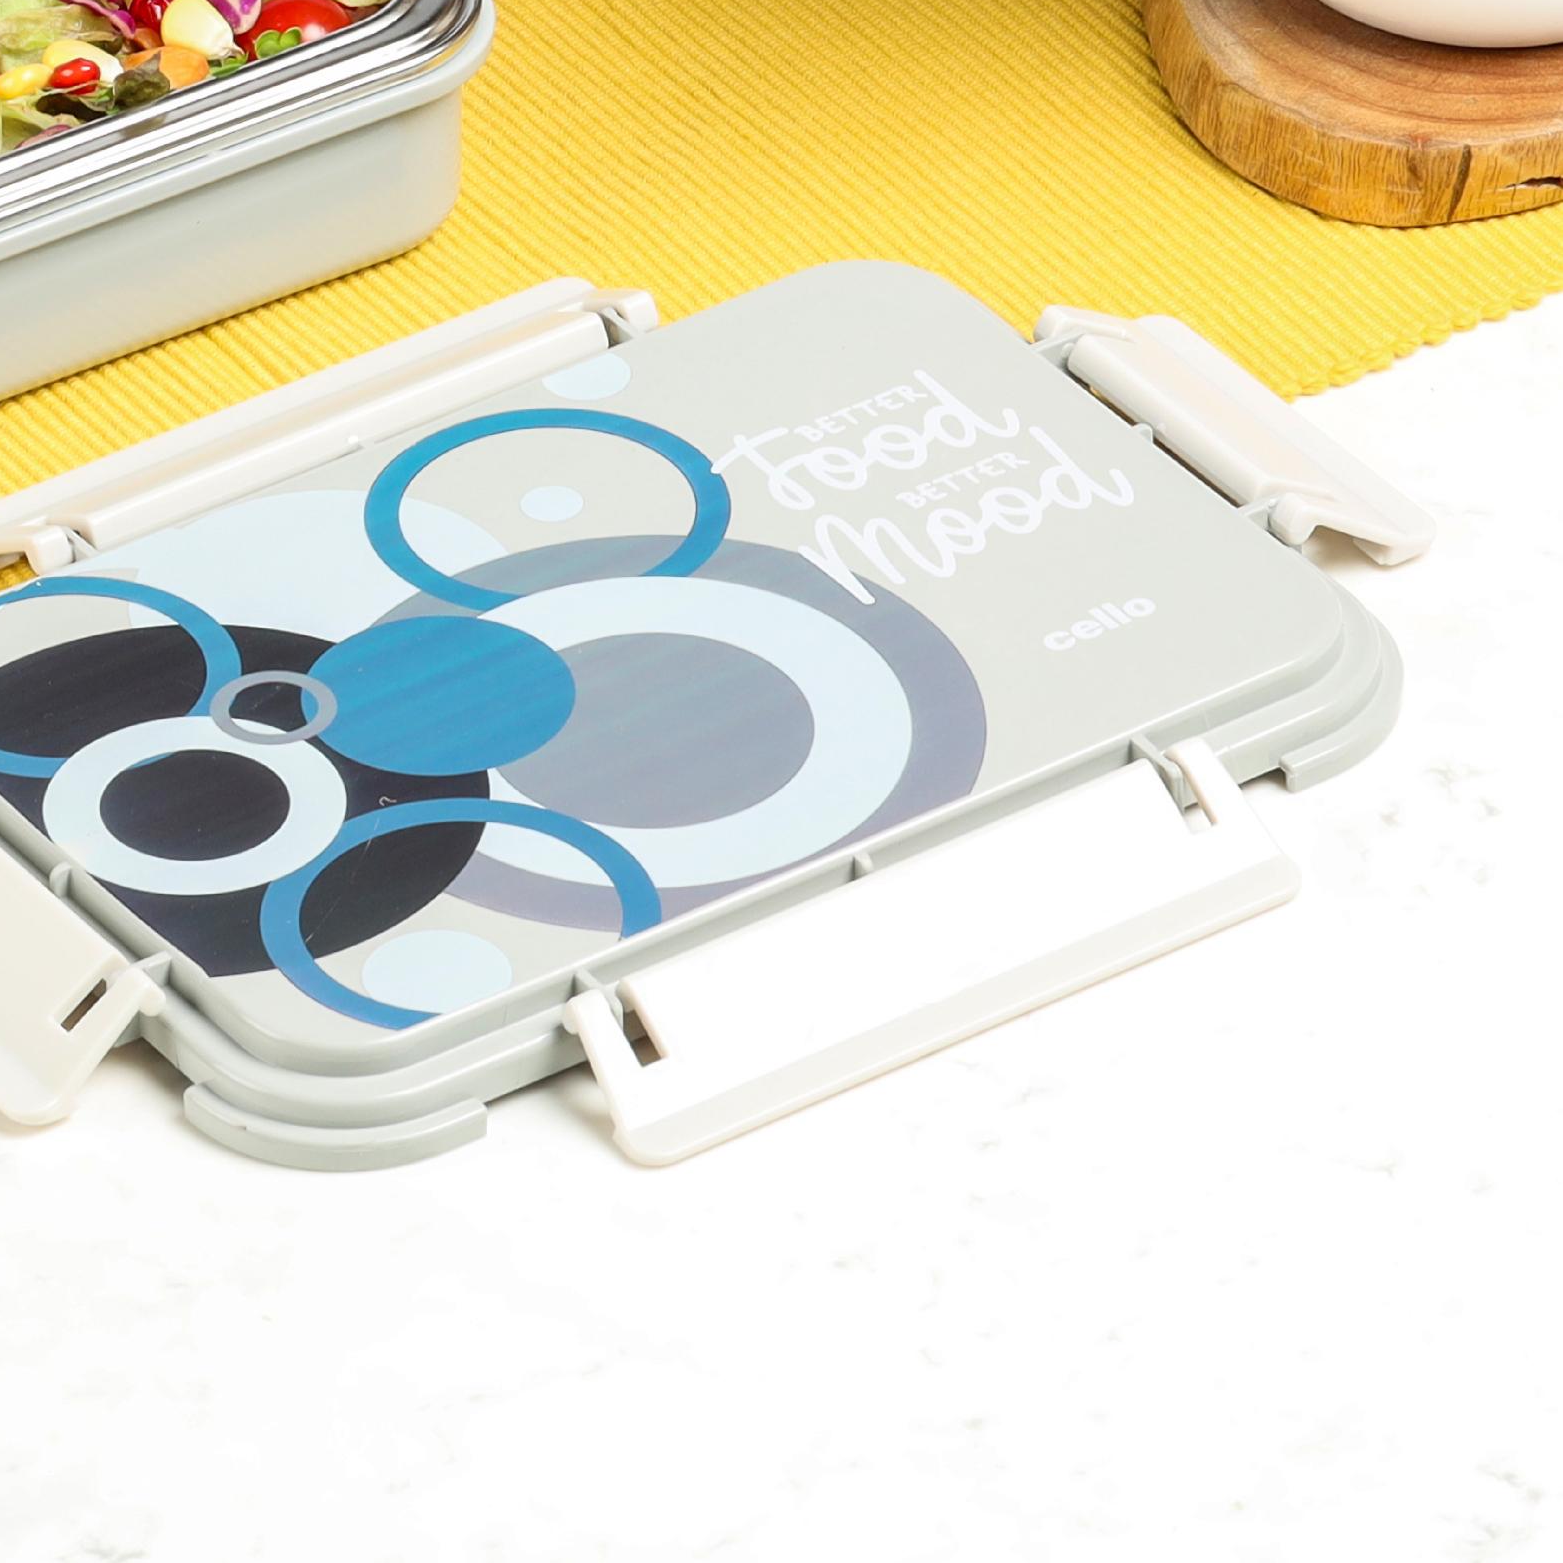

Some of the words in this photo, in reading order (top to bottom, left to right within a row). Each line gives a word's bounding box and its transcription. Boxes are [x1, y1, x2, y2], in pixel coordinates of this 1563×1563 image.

[794, 384, 927, 443] BETTER
[896, 452, 1030, 509] BETTER
[1043, 597, 1156, 651] cello
